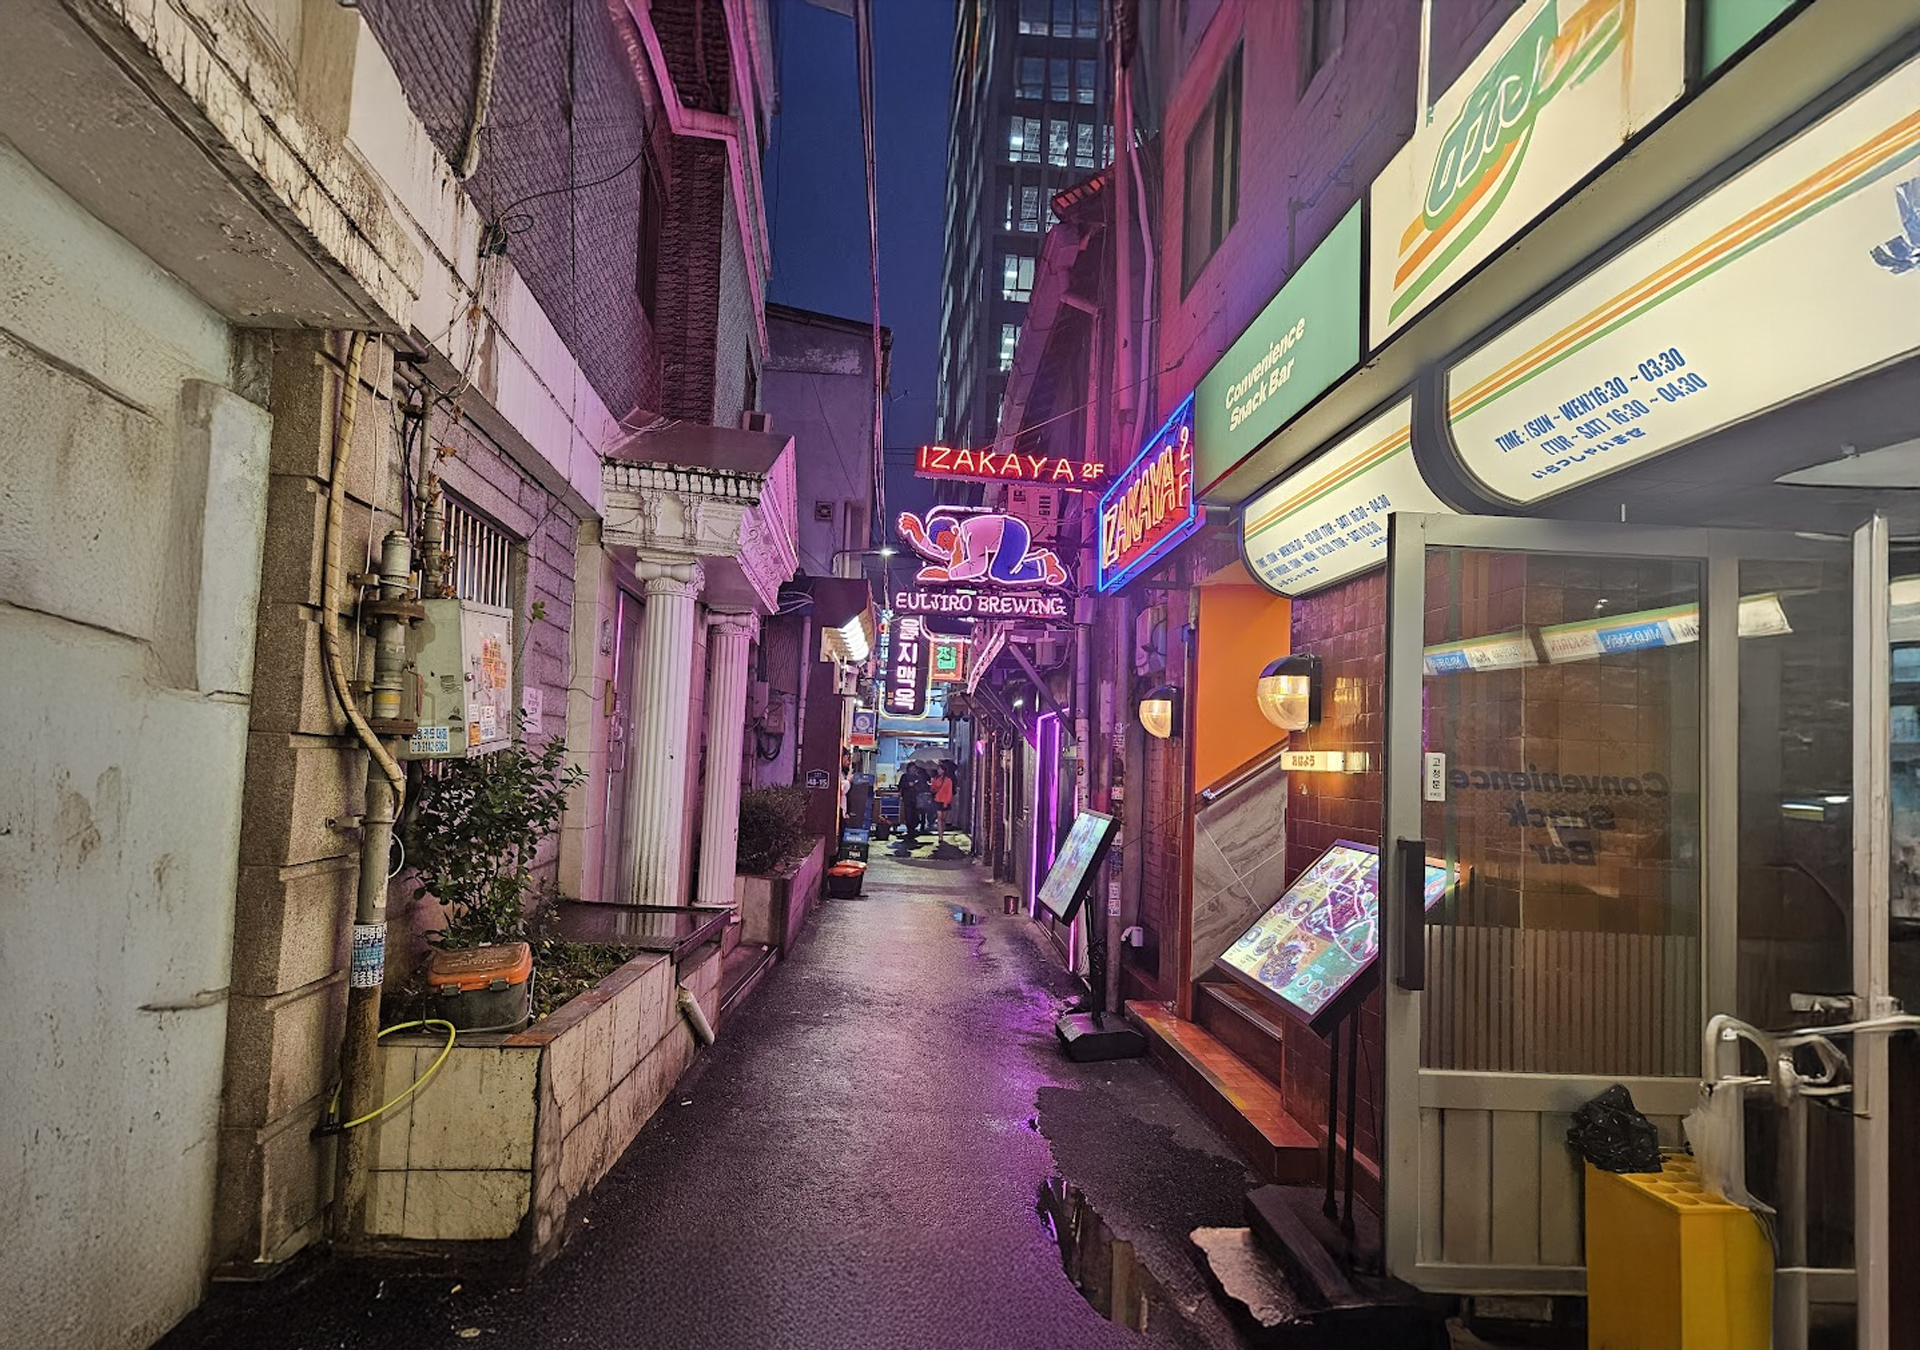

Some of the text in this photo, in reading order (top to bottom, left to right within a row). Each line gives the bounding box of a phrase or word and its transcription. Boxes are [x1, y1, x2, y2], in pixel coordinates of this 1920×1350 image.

[1226, 318, 1305, 407] Convenience
[1229, 357, 1294, 431] Snack Bar
[1606, 399, 1650, 426] 16:30
[1656, 372, 1708, 403] 04:30
[1495, 429, 1524, 453] TIME
[1638, 347, 1687, 383] 03:30
[921, 445, 1104, 483] IZAKAYA 2F
[1531, 427, 1647, 479] いらっしゃいませ
[1102, 445, 1175, 569] IZAKAYA
[896, 592, 1067, 615] EULJIRO BREWING
[893, 618, 920, 710] 을지맥옥
